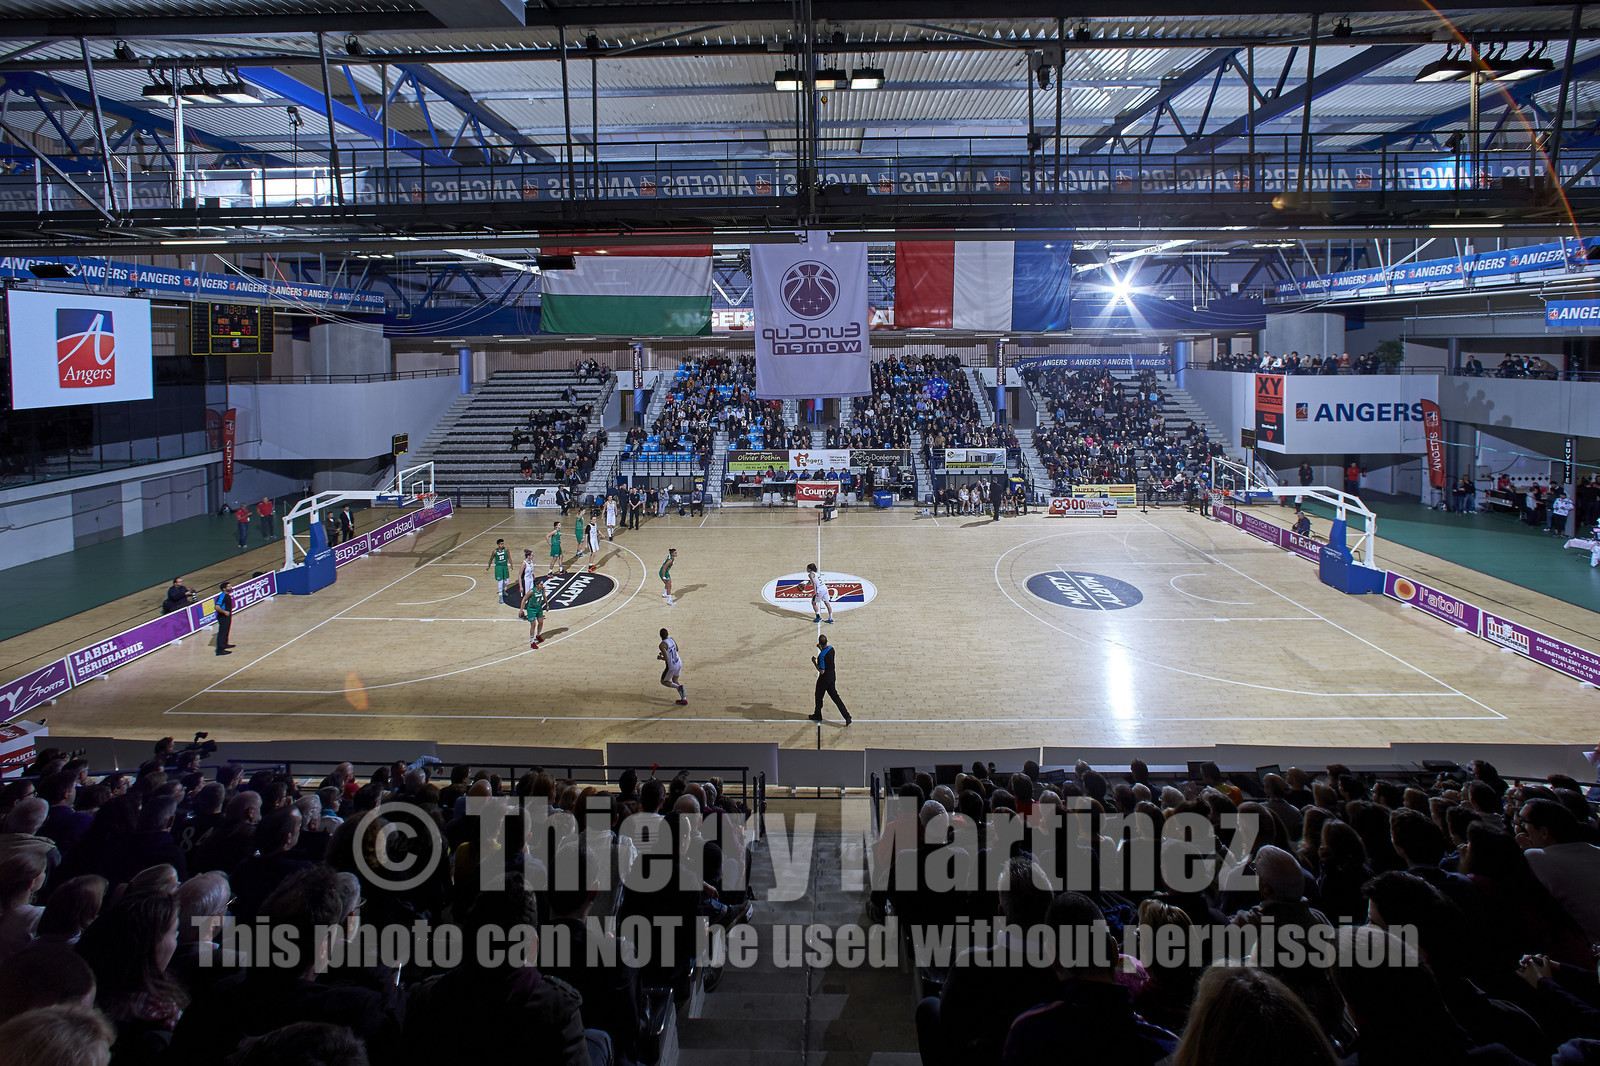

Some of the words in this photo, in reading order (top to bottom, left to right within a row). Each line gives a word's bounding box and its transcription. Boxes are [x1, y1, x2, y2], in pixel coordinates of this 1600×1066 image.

[1463, 257, 1507, 272] ANGERS
[1519, 248, 1572, 266] ANGERS
[78, 264, 129, 281] ANGERS
[139, 270, 181, 286] ANGERS
[1372, 270, 1406, 282] ANGERS
[1415, 263, 1453, 278] ANGERS
[1338, 274, 1367, 286] ANGERS
[236, 282, 267, 294] ANGERS
[275, 286, 303, 297] ANGERS
[1042, 359, 1068, 367] ANGERS
[1075, 358, 1101, 366] ANGERS
[1107, 358, 1134, 366] ANGERS
[1140, 358, 1166, 366] ANGERS
[63, 366, 113, 385] Angers
[1258, 377, 1282, 395] XY
[1314, 402, 1425, 422] ANGERS
[737, 452, 760, 461] Olivier
[760, 452, 781, 461] Pothin
[802, 486, 836, 496] Courrier
[383, 517, 414, 541] randstad
[1289, 533, 1298, 545] In
[555, 575, 595, 606] MARTY
[1045, 575, 1092, 606] MARTY
[1074, 575, 1127, 606] MARTY
[1419, 586, 1464, 619] l'atoll
[1496, 633, 1528, 650] BOUCHERIE
[1536, 636, 1560, 650] ANGERS
[74, 640, 118, 667] LABEL
[77, 641, 145, 678] SÉRIGRAPHIE
